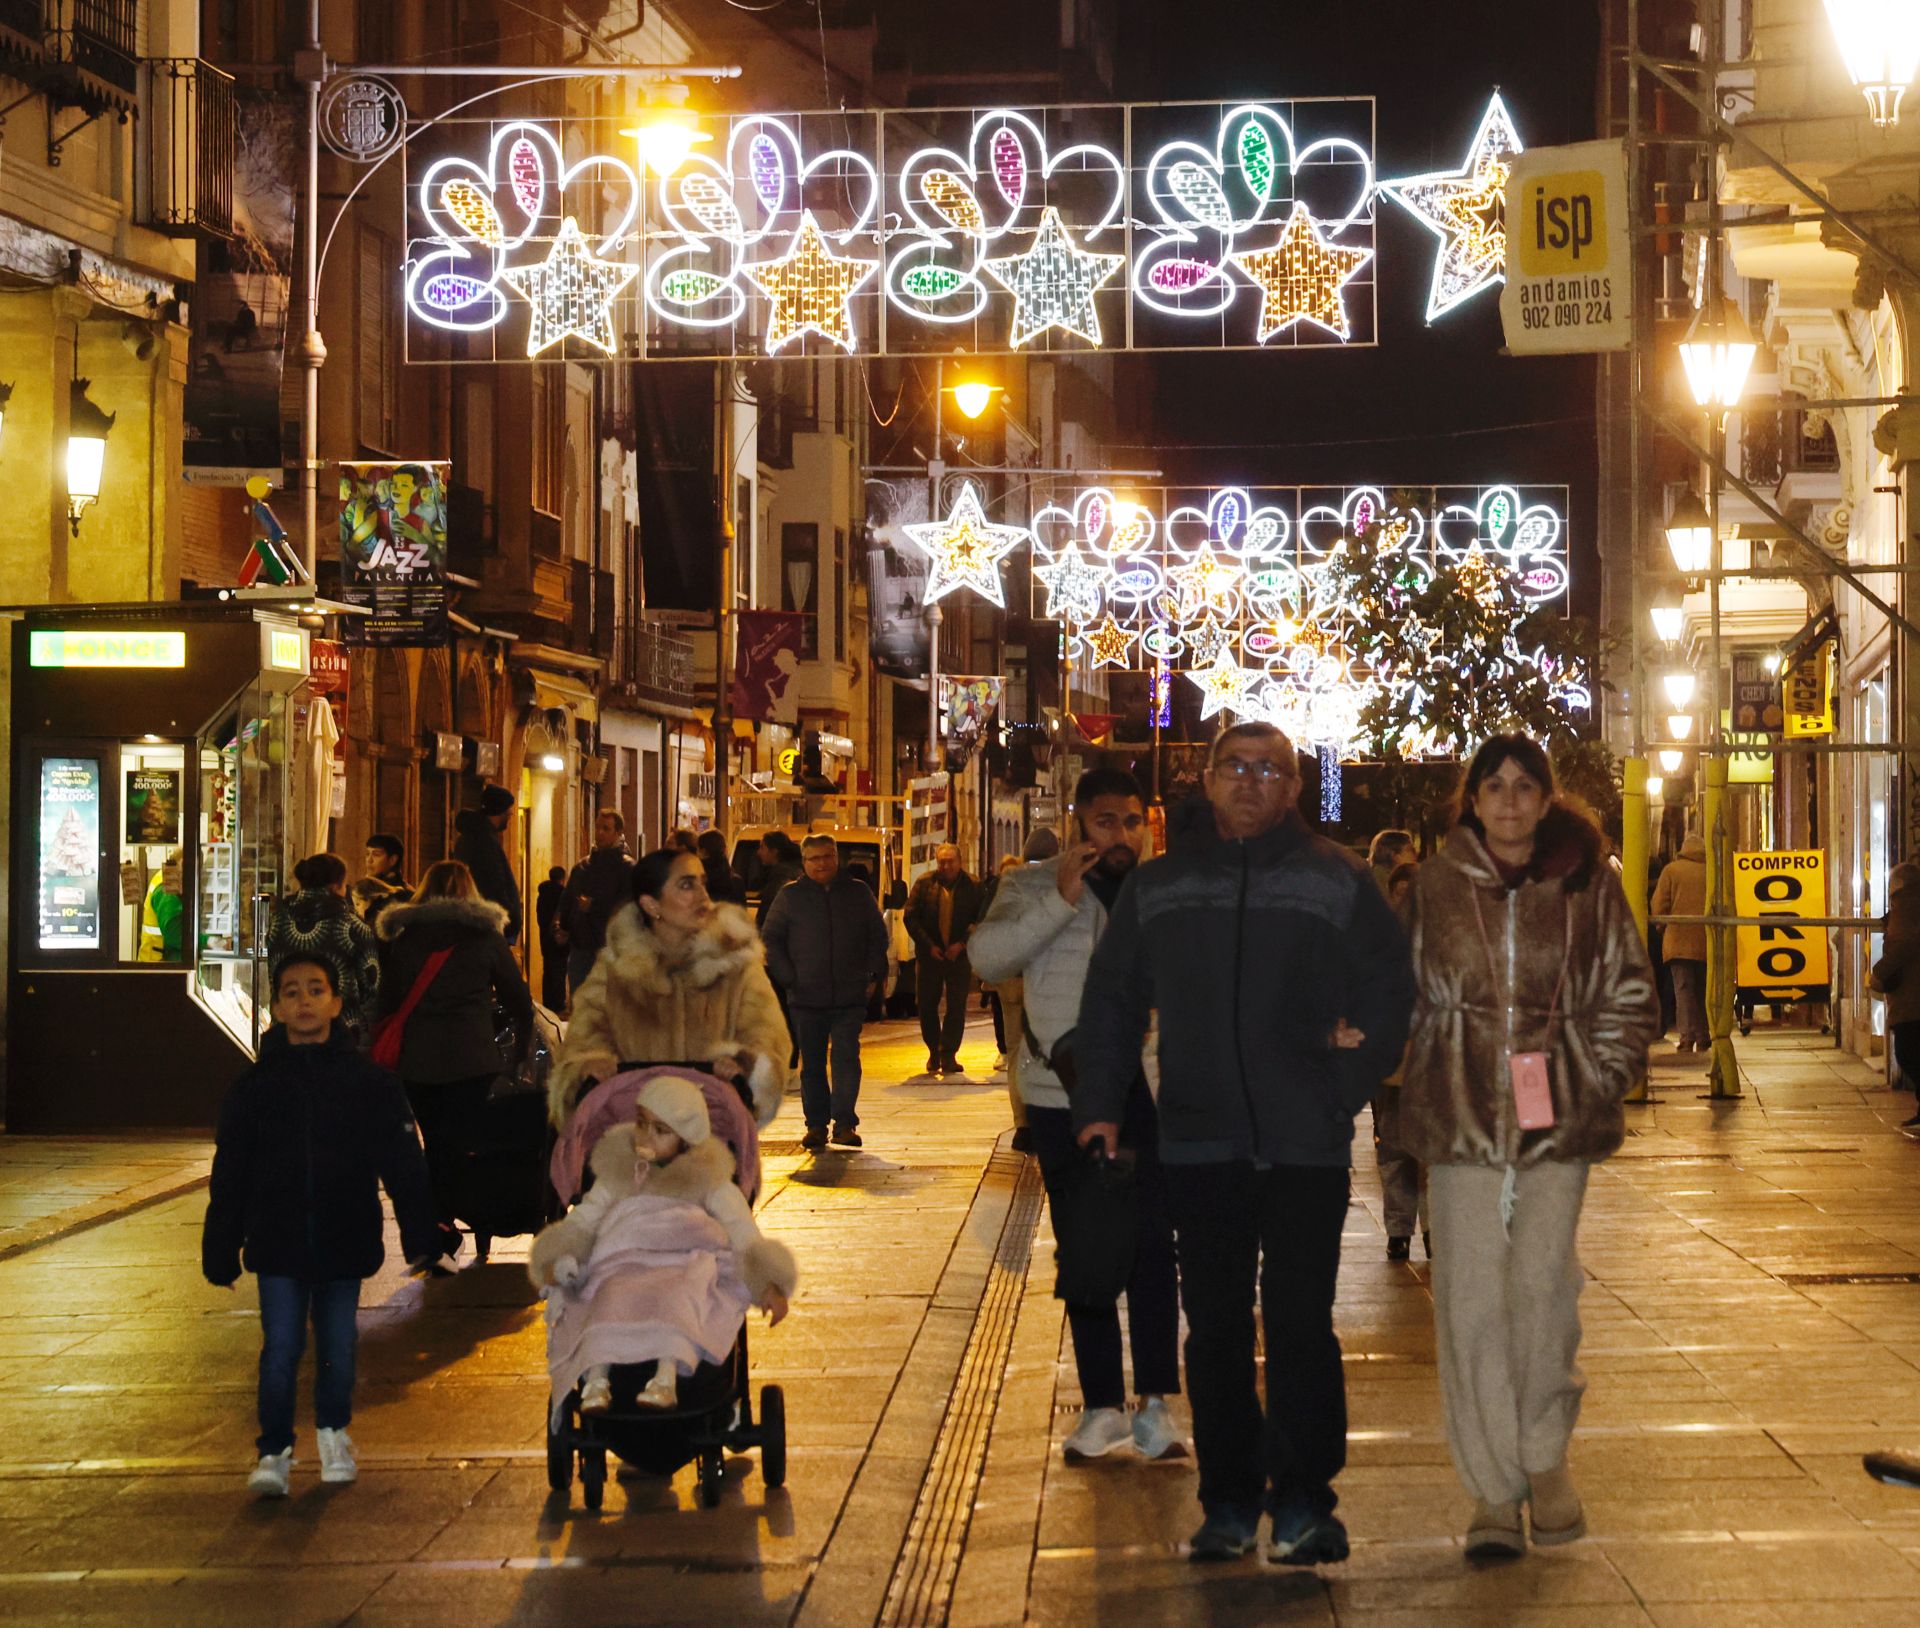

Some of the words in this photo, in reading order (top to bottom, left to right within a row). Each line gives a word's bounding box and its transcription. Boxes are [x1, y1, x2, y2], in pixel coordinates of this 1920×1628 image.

[1536, 187, 1592, 259] isp
[1520, 275, 1611, 304] andamios
[1522, 306, 1549, 329] 902
[1555, 303, 1580, 326] 090
[1586, 301, 1612, 324] 224
[357, 538, 430, 573] JAZZ
[79, 639, 170, 660] ONCE
[1738, 856, 1818, 870] COMPRO
[1754, 875, 1806, 977] ORO
